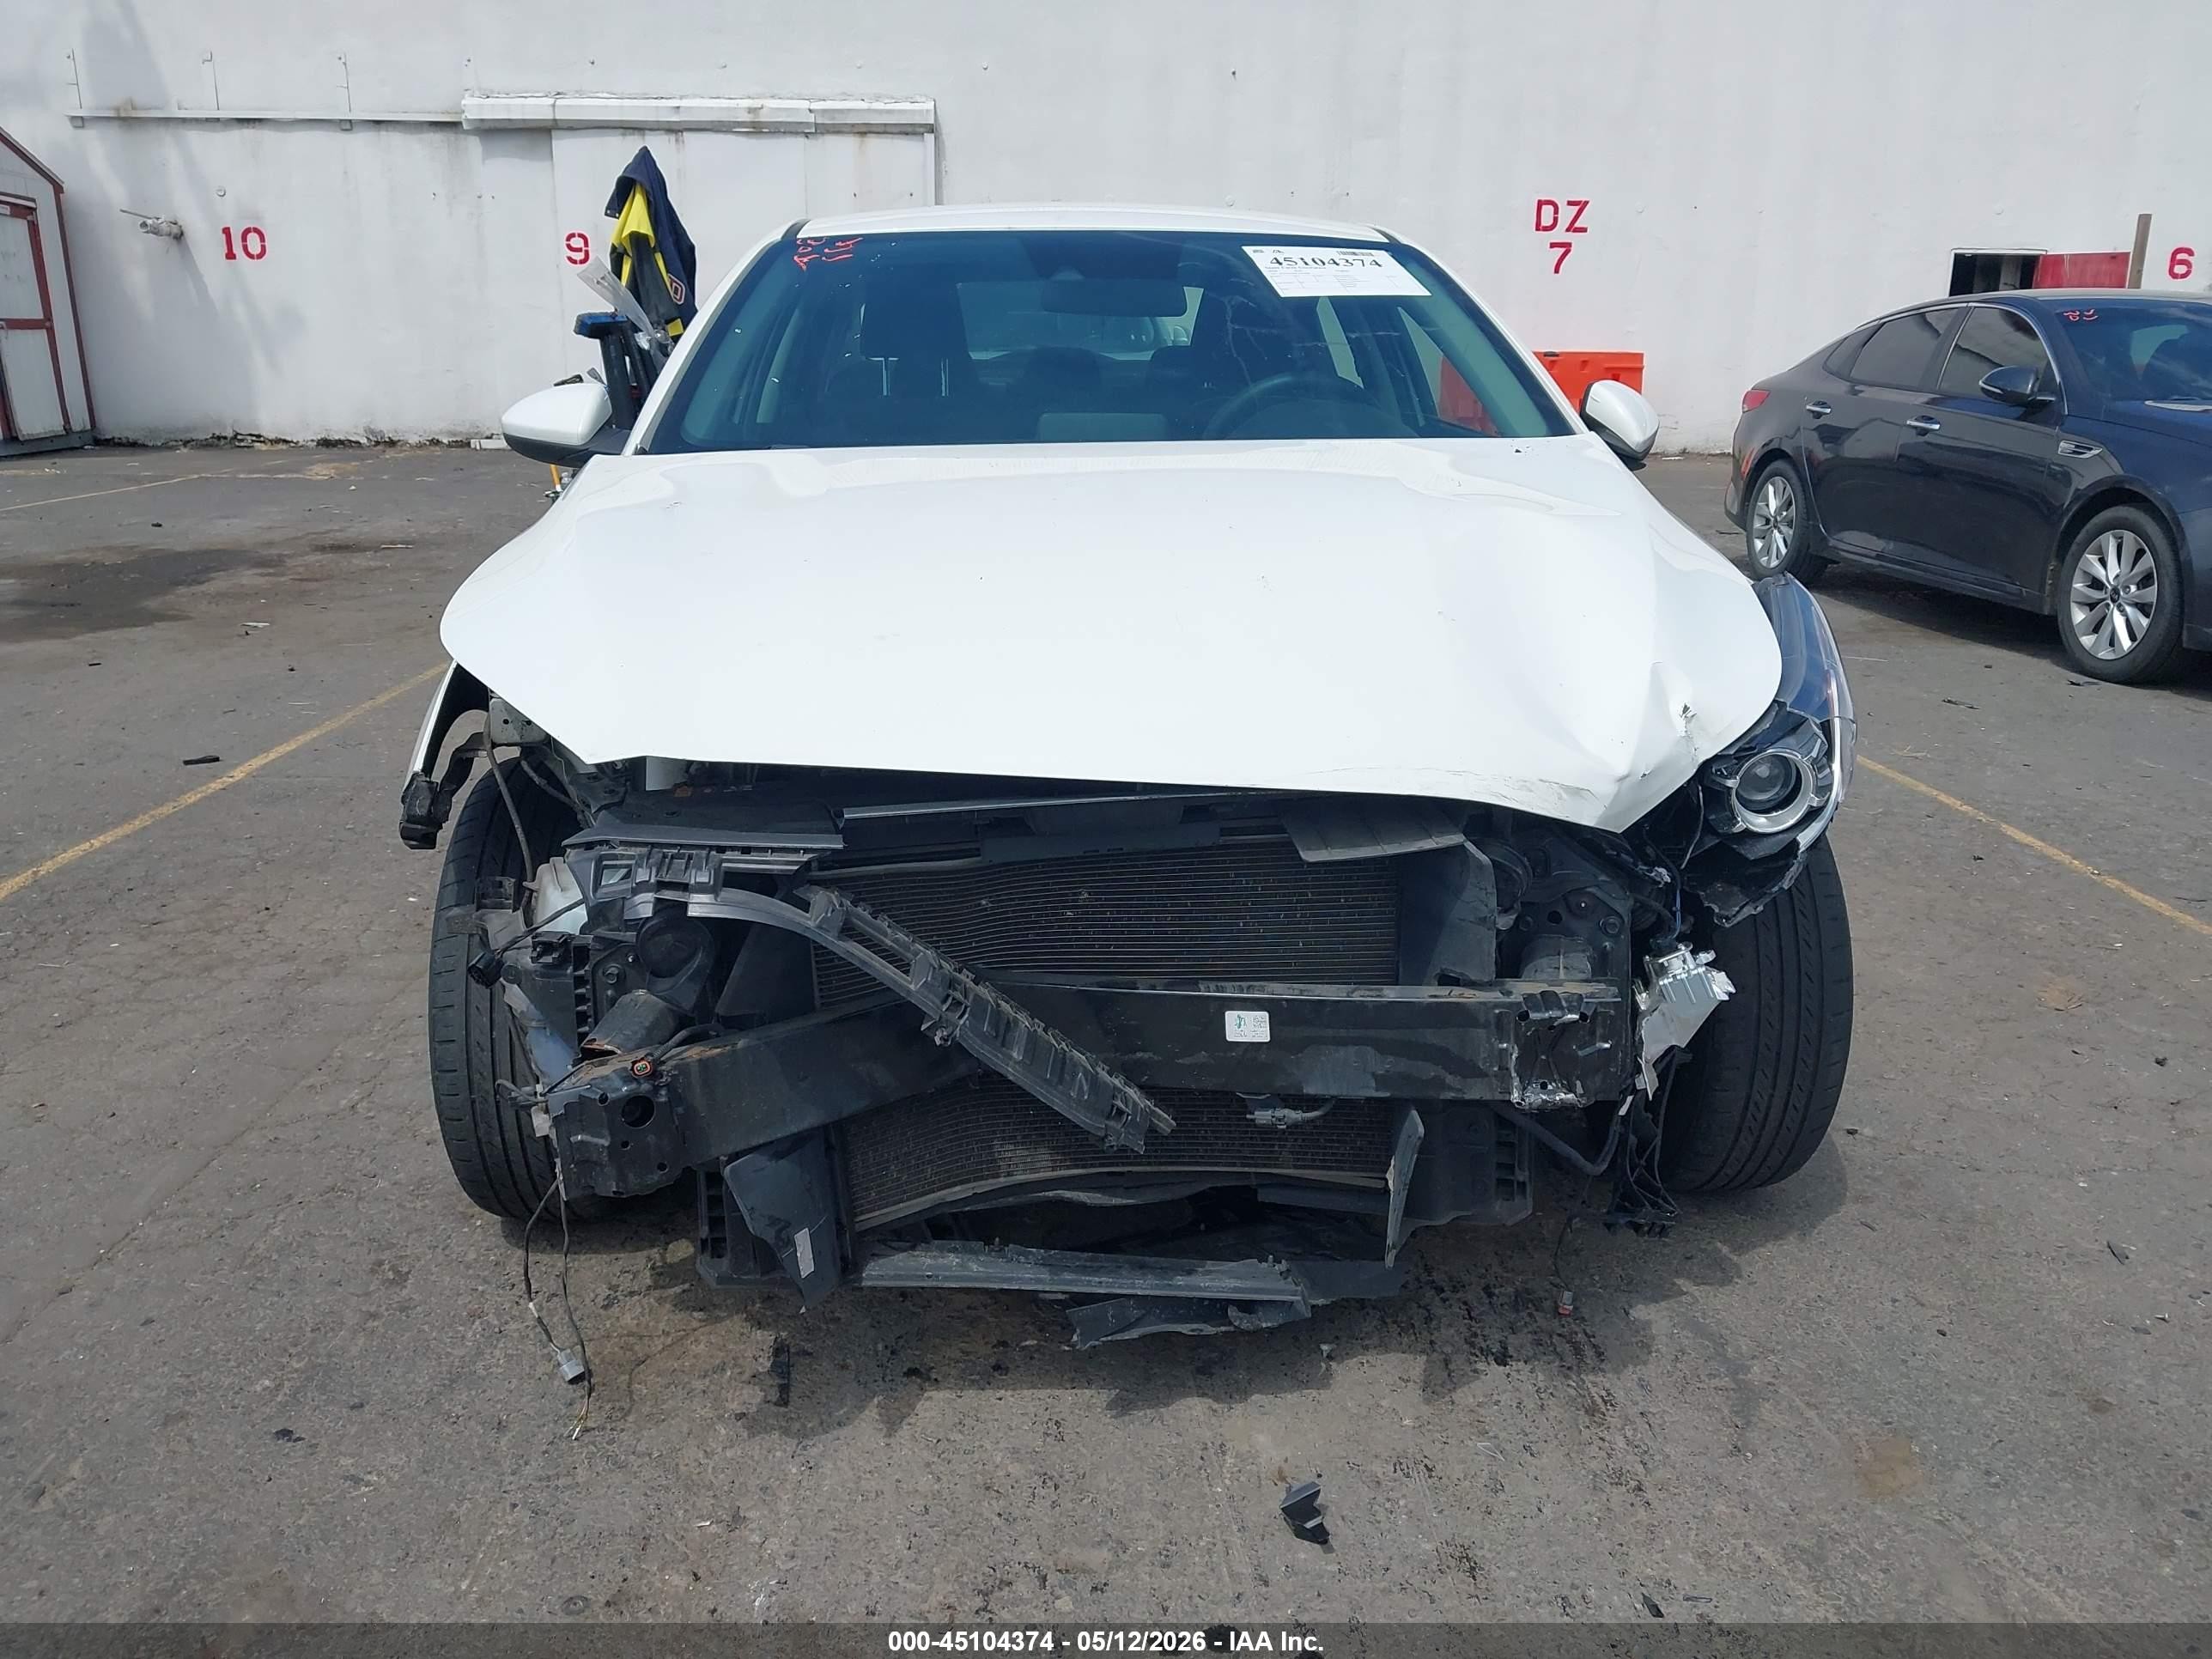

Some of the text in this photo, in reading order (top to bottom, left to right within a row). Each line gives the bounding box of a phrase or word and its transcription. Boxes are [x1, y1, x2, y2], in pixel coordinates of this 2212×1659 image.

[1534, 198, 1589, 234] DZ
[222, 226, 267, 261] 10
[565, 232, 591, 266] 9
[1548, 240, 1573, 275] 7
[1269, 256, 1383, 268] 45104374
[2166, 246, 2195, 280] 6
